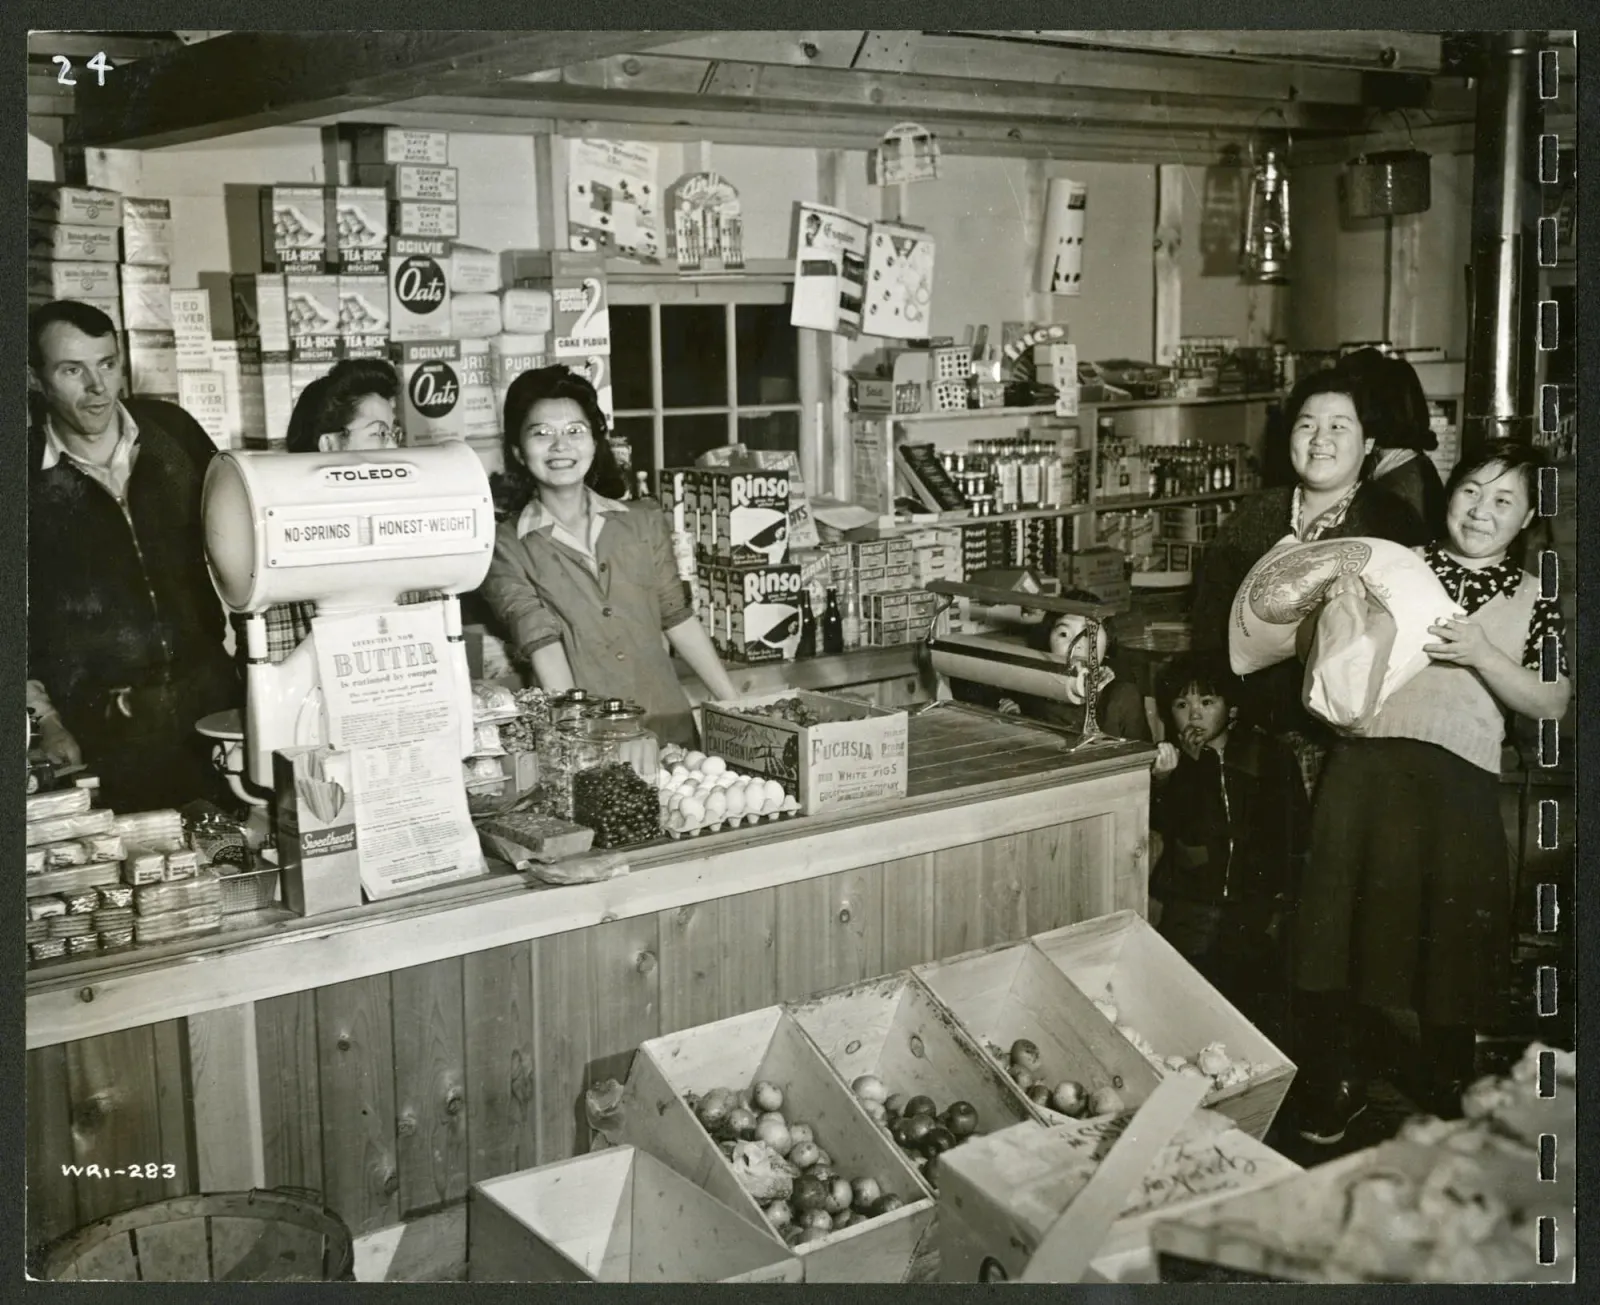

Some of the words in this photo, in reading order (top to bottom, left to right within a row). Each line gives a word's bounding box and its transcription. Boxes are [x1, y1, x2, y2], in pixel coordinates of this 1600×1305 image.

[397, 240, 444, 254] OGILVIE
[398, 267, 444, 301] Oats
[410, 346, 456, 360] OGILVIE
[558, 340, 581, 348] CAKE
[584, 337, 607, 347] FLOUR
[414, 373, 457, 406] Oats
[330, 468, 408, 481] TOLEDO
[731, 474, 788, 506] Rinso
[284, 524, 351, 543] NO-SPRINGS
[378, 516, 472, 537] HONEST-WEIGHT
[744, 570, 801, 603] Rinso
[332, 642, 438, 678] BUTTER
[407, 668, 438, 678] coupon
[812, 739, 872, 766] FUCHSIA
[838, 770, 868, 780] WHITE
[873, 764, 897, 776] FIGS
[302, 828, 354, 850] Sweetheart
